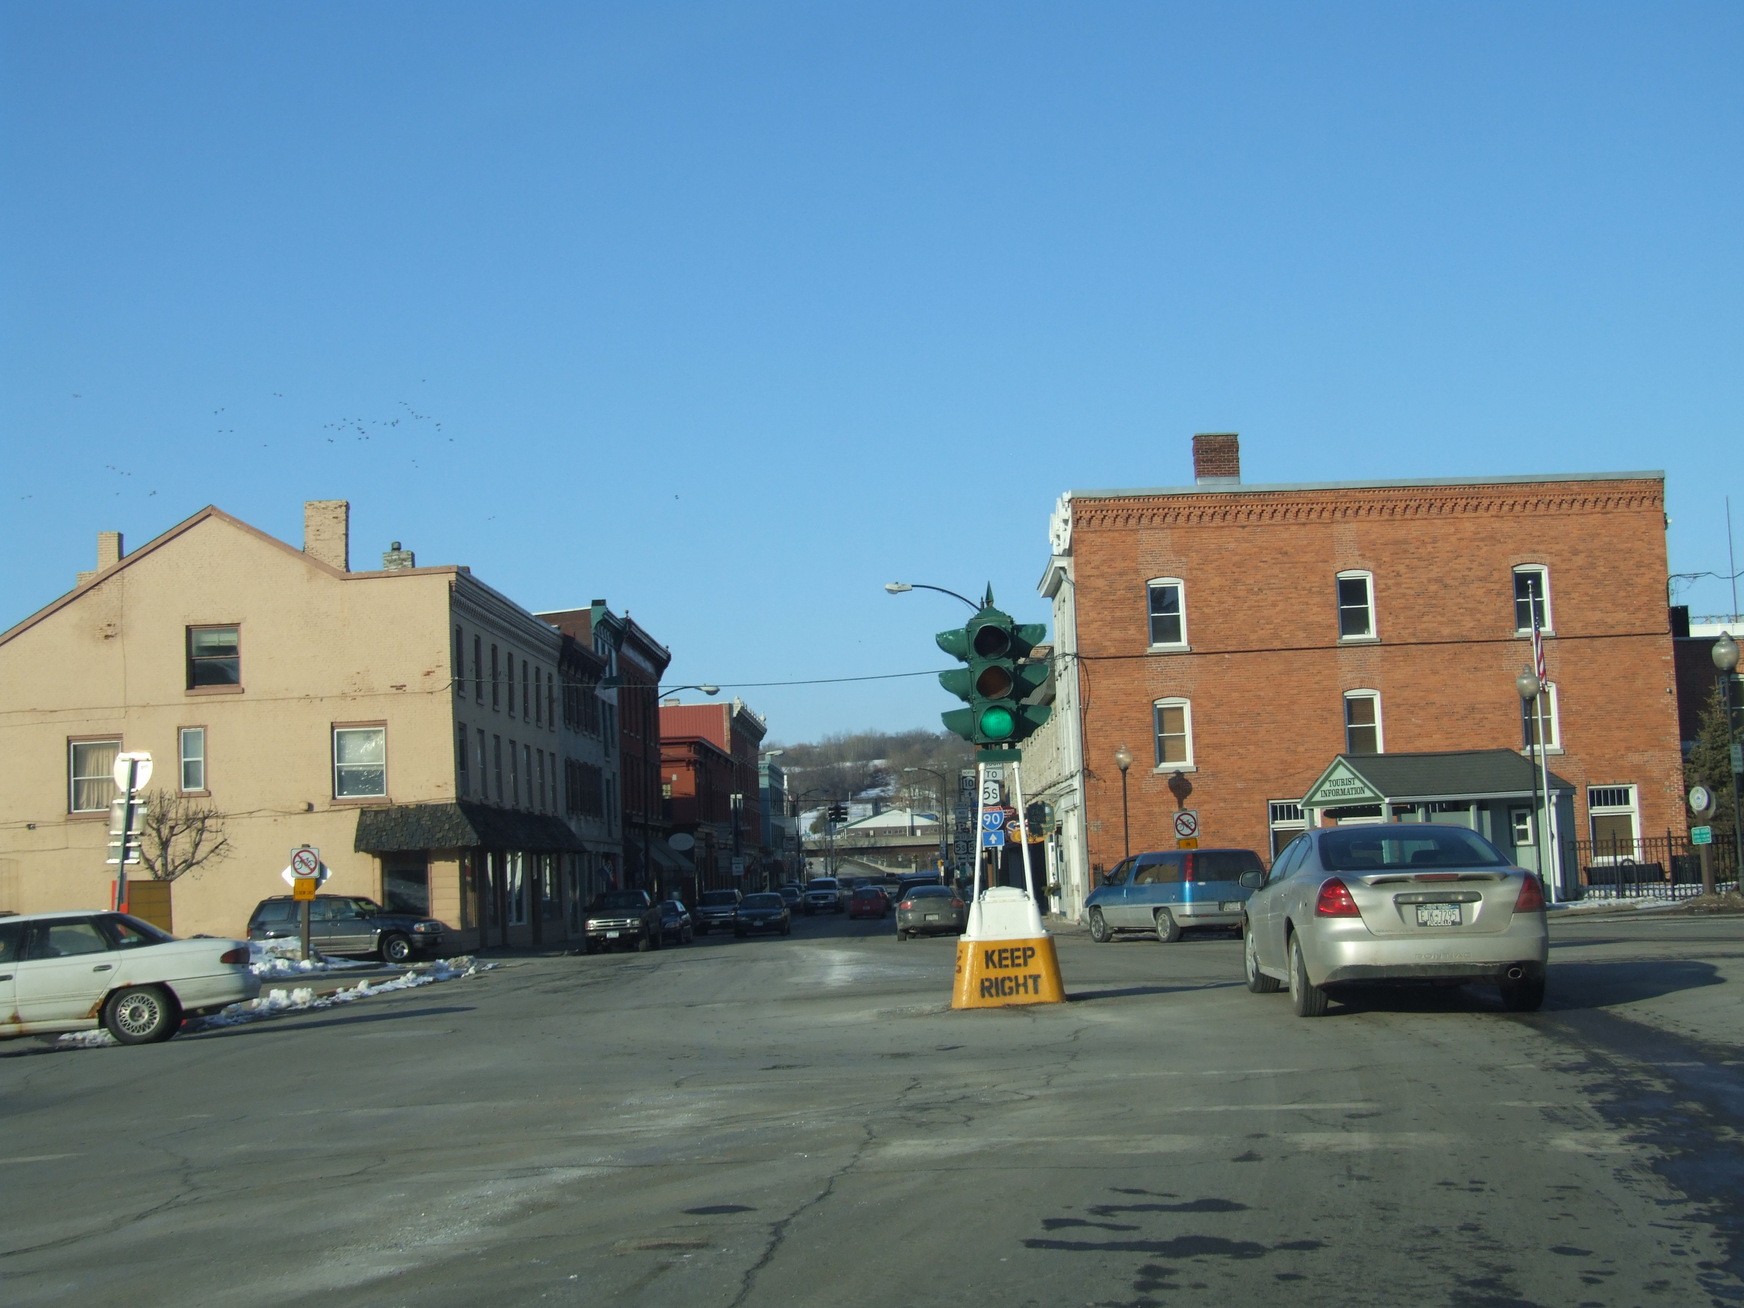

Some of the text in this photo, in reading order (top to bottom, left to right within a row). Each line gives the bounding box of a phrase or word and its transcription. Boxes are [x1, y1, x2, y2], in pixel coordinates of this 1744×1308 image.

[986, 770, 997, 778] TO
[964, 778, 974, 787] 10
[1328, 777, 1356, 787] TOURIST
[984, 787, 998, 800] 5S
[1320, 786, 1366, 798] INFORMATION
[983, 813, 1000, 825] 90
[955, 843, 966, 852] 5S
[984, 946, 1035, 970] KEEP
[980, 973, 1042, 999] RIGHT
